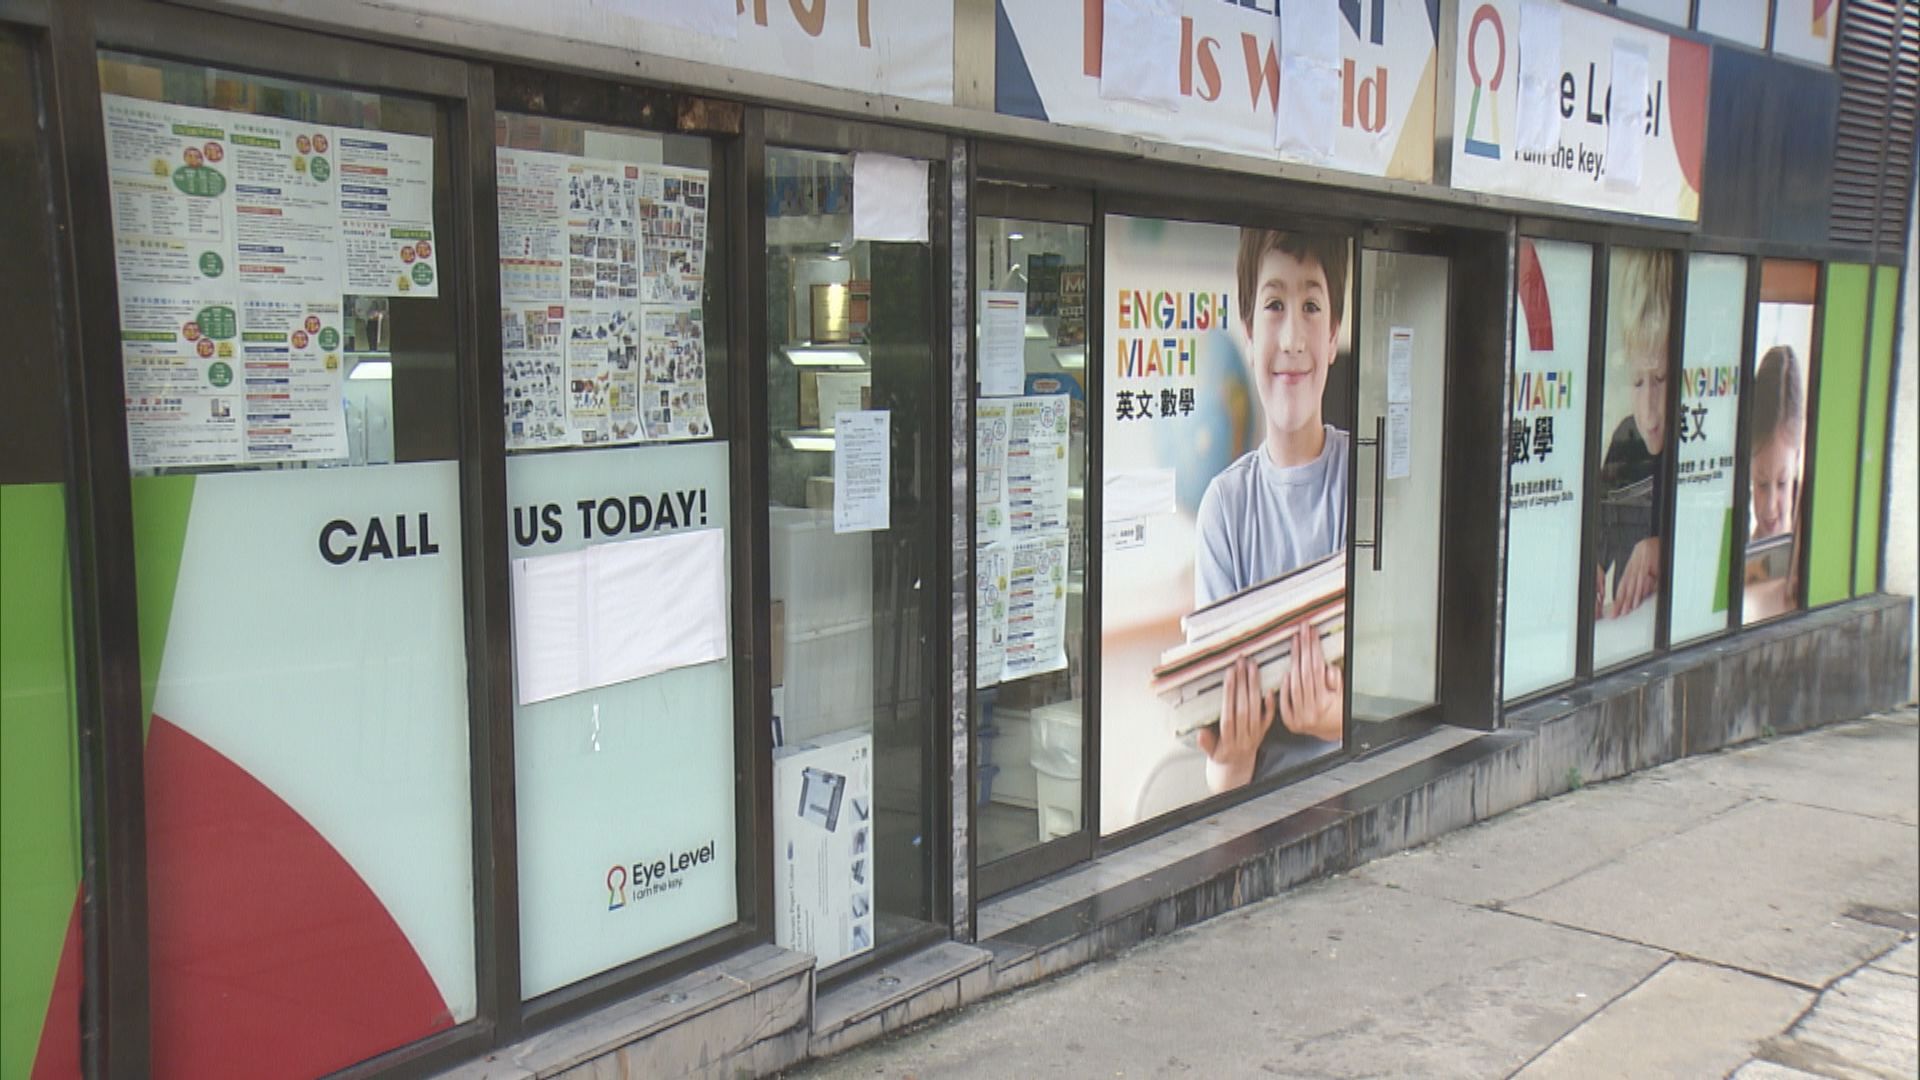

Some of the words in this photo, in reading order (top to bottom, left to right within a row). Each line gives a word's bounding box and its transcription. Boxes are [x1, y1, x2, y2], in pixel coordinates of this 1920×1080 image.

[1578, 142, 1605, 181] key.
[1118, 290, 1229, 331] ENGLISH
[1117, 337, 1196, 379] MATH
[319, 513, 440, 565] CALL
[513, 503, 563, 547] US
[577, 488, 708, 539] TODAY!
[632, 861, 666, 888] Eye
[669, 839, 715, 873] Level
